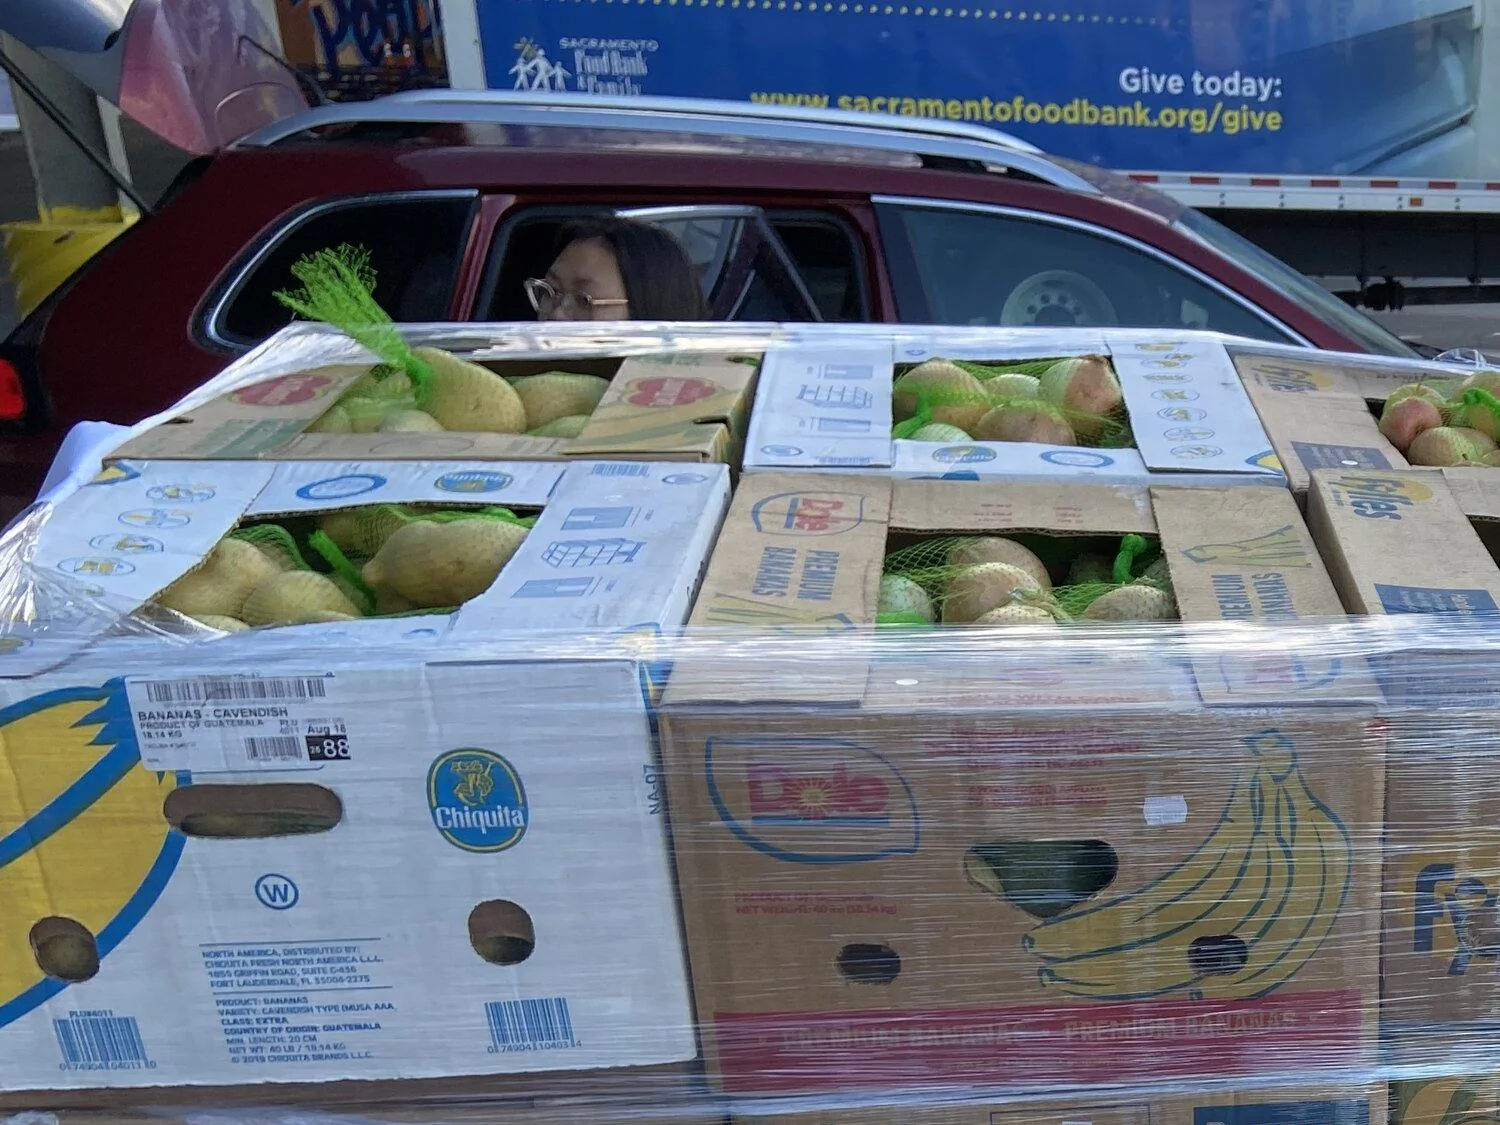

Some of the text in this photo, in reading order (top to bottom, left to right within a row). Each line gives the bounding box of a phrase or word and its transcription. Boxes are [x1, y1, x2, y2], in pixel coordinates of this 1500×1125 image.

[559, 37, 660, 52] SACRAMENTO
[1118, 66, 1283, 102] Give today:
[750, 90, 1283, 134] wwwsacramentofoodbank.org/give
[138, 709, 202, 721] BANANAS
[213, 706, 289, 719] CAVENDISH
[140, 719, 265, 730] PRODUCT OF GUATEMALA
[168, 729, 183, 738] KG
[307, 725, 331, 737] Aug
[323, 738, 350, 759] 88
[746, 762, 890, 820] Dole
[435, 805, 525, 834] Chiquita
[262, 883, 289, 904] W
[203, 951, 235, 959] NORTH
[237, 949, 281, 958] AMERICA,
[283, 947, 343, 956] DISTRIBUTED
[205, 960, 249, 969] CHIQUITA
[251, 959, 280, 967] FRESH
[282, 957, 314, 966] NORTH
[316, 956, 358, 964] AMERICA
[302, 967, 328, 975] SUITE
[210, 980, 235, 988] FORT
[301, 977, 312, 985] FL
[263, 997, 309, 1005] BANANAS
[262, 1005, 314, 1015] CAVENDISH
[315, 1004, 340, 1013] TYPE
[256, 1016, 289, 1025] EXTRA
[224, 1027, 269, 1036] COUNTRY
[271, 1026, 284, 1034] OF
[323, 1023, 382, 1032] GUATEMALA
[302, 1034, 318, 1043] CM
[267, 1054, 310, 1063] CHIQUITA
[312, 1052, 349, 1061] BRANDS
